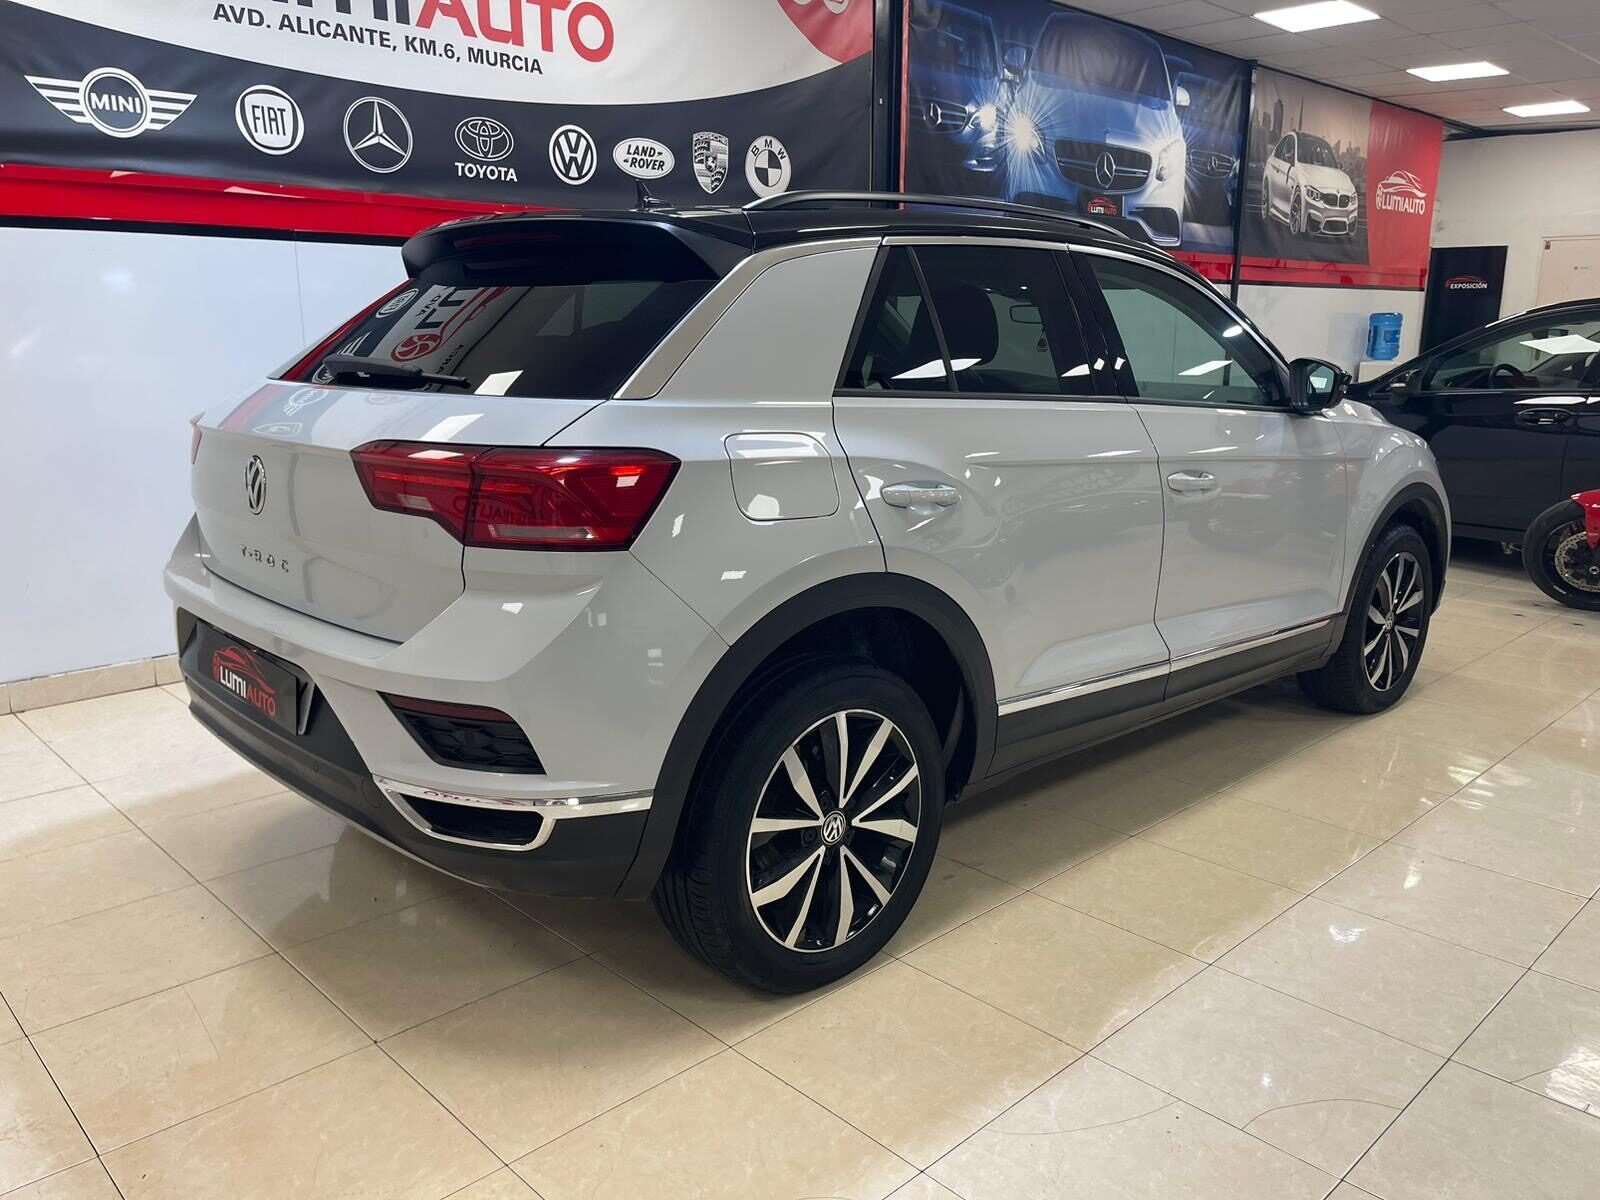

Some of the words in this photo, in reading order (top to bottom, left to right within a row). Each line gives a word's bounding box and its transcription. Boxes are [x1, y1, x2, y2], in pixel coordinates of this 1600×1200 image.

[213, 3, 271, 28] AVD.
[278, 14, 397, 52] ALICANTE,
[404, 35, 461, 63] KM.6,
[468, 47, 543, 75] MURCIA
[90, 92, 142, 114] MINI
[252, 105, 288, 137] FIAT
[626, 144, 656, 158] LAND
[751, 139, 786, 161] BMW
[454, 162, 518, 182] TOYOTA
[629, 158, 665, 171] ROVER
[1382, 194, 1426, 215] LUMIAUTO
[1450, 281, 1488, 290] EXPOSICIÓN
[220, 666, 276, 717] LUMIAUTO
